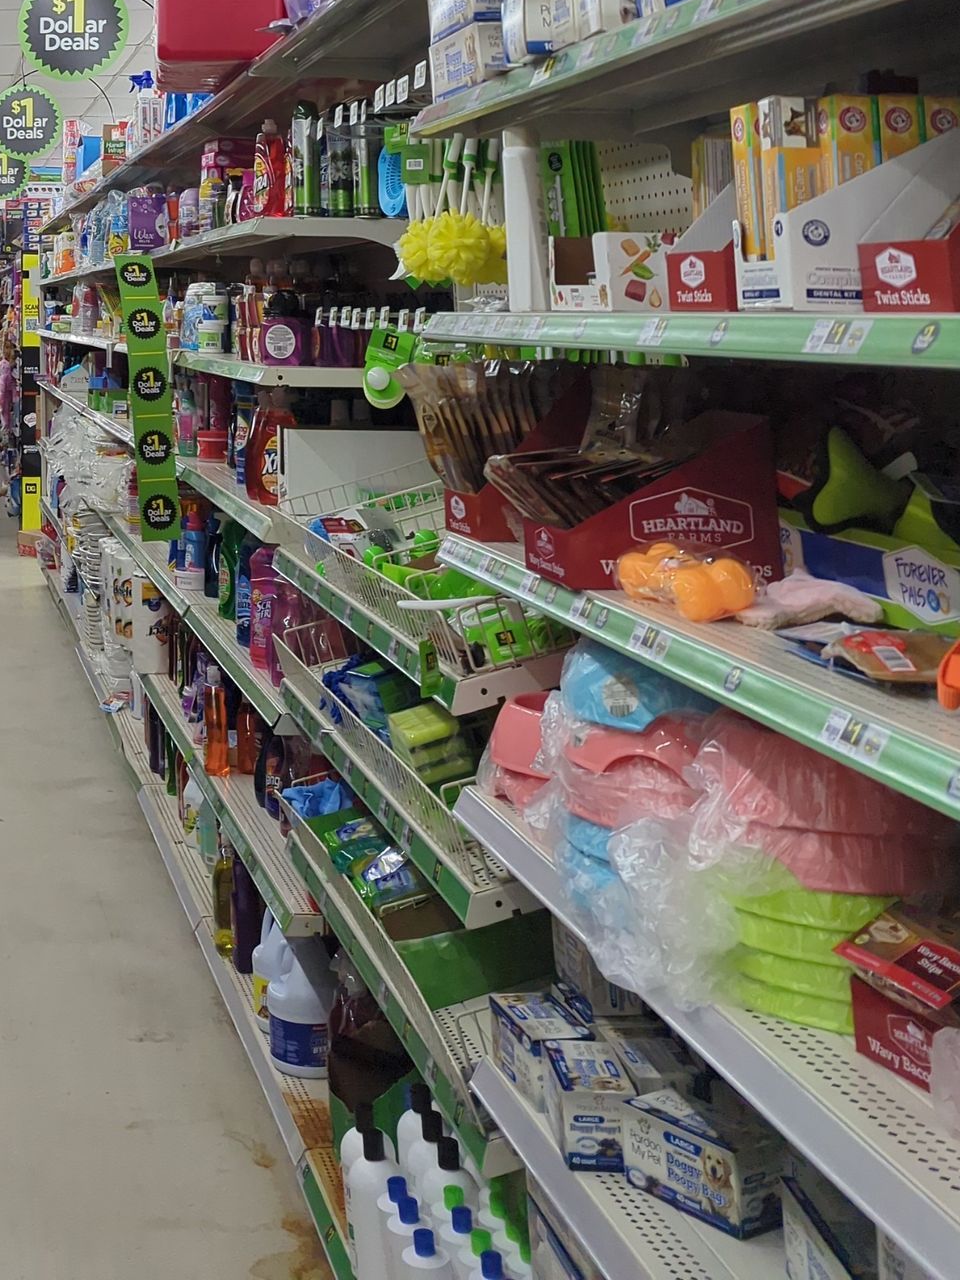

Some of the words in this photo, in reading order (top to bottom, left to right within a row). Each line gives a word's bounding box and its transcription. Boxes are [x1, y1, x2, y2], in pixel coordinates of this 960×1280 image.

[39, 17, 107, 35] Dollar
[45, 32, 100, 52] Deals
[11, 97, 34, 128] $1
[2, 115, 49, 129] Dollar
[6, 127, 44, 141] Deals
[676, 291, 693, 303] Twist
[693, 290, 712, 303] Sticks
[813, 289, 843, 298] DENTAL
[843, 289, 857, 298] KIT
[874, 290, 900, 305] Twist
[900, 288, 932, 305] Sticks
[134, 325, 155, 333] Deals
[140, 386, 160, 394] Deals
[145, 450, 166, 458] Deals
[26, 484, 37, 493] DG
[149, 514, 170, 523] Deals
[641, 517, 745, 535] HEARTLAND
[894, 556, 949, 588] FOREVER
[899, 582, 927, 608] PALS
[916, 944, 941, 963] Wavy
[917, 957, 945, 977] Strips
[866, 1035, 901, 1069] Wavy
[669, 1133, 697, 1155] LARGE
[645, 1148, 662, 1168] Pet
[666, 1149, 703, 1180] Doggy
[666, 1168, 702, 1200] Poopy
